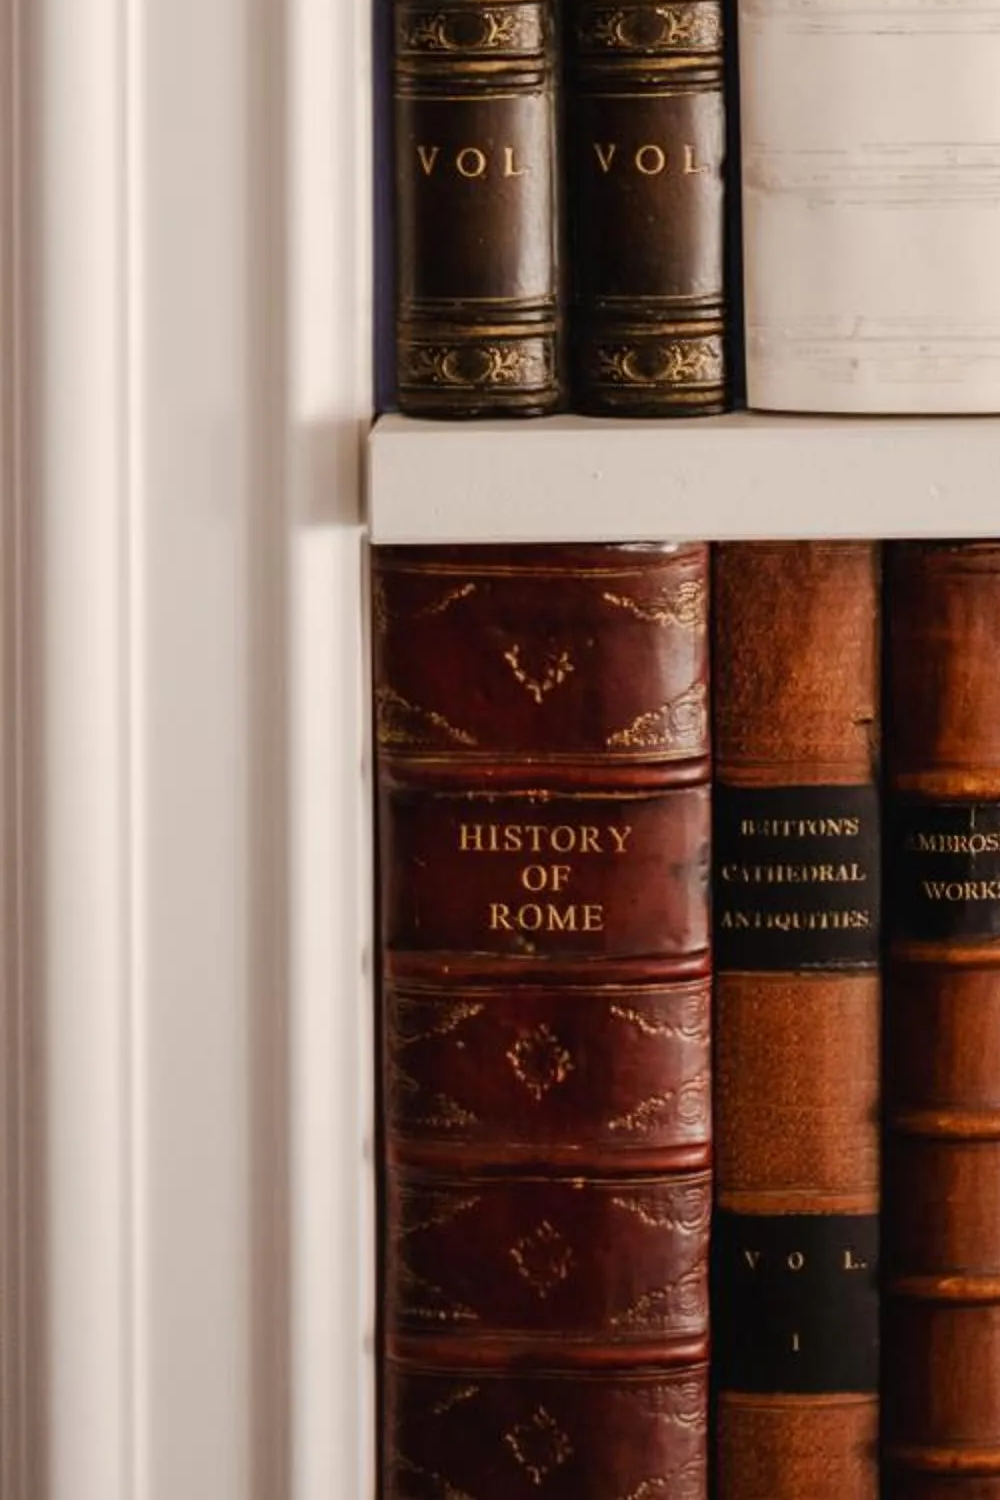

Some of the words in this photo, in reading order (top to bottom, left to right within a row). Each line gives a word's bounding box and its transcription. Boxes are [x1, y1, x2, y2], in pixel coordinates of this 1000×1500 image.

[460, 824, 632, 852] HISTORY
[522, 865, 571, 891] OF
[722, 863, 866, 883] CATHEDRAL
[489, 903, 604, 931] ROME
